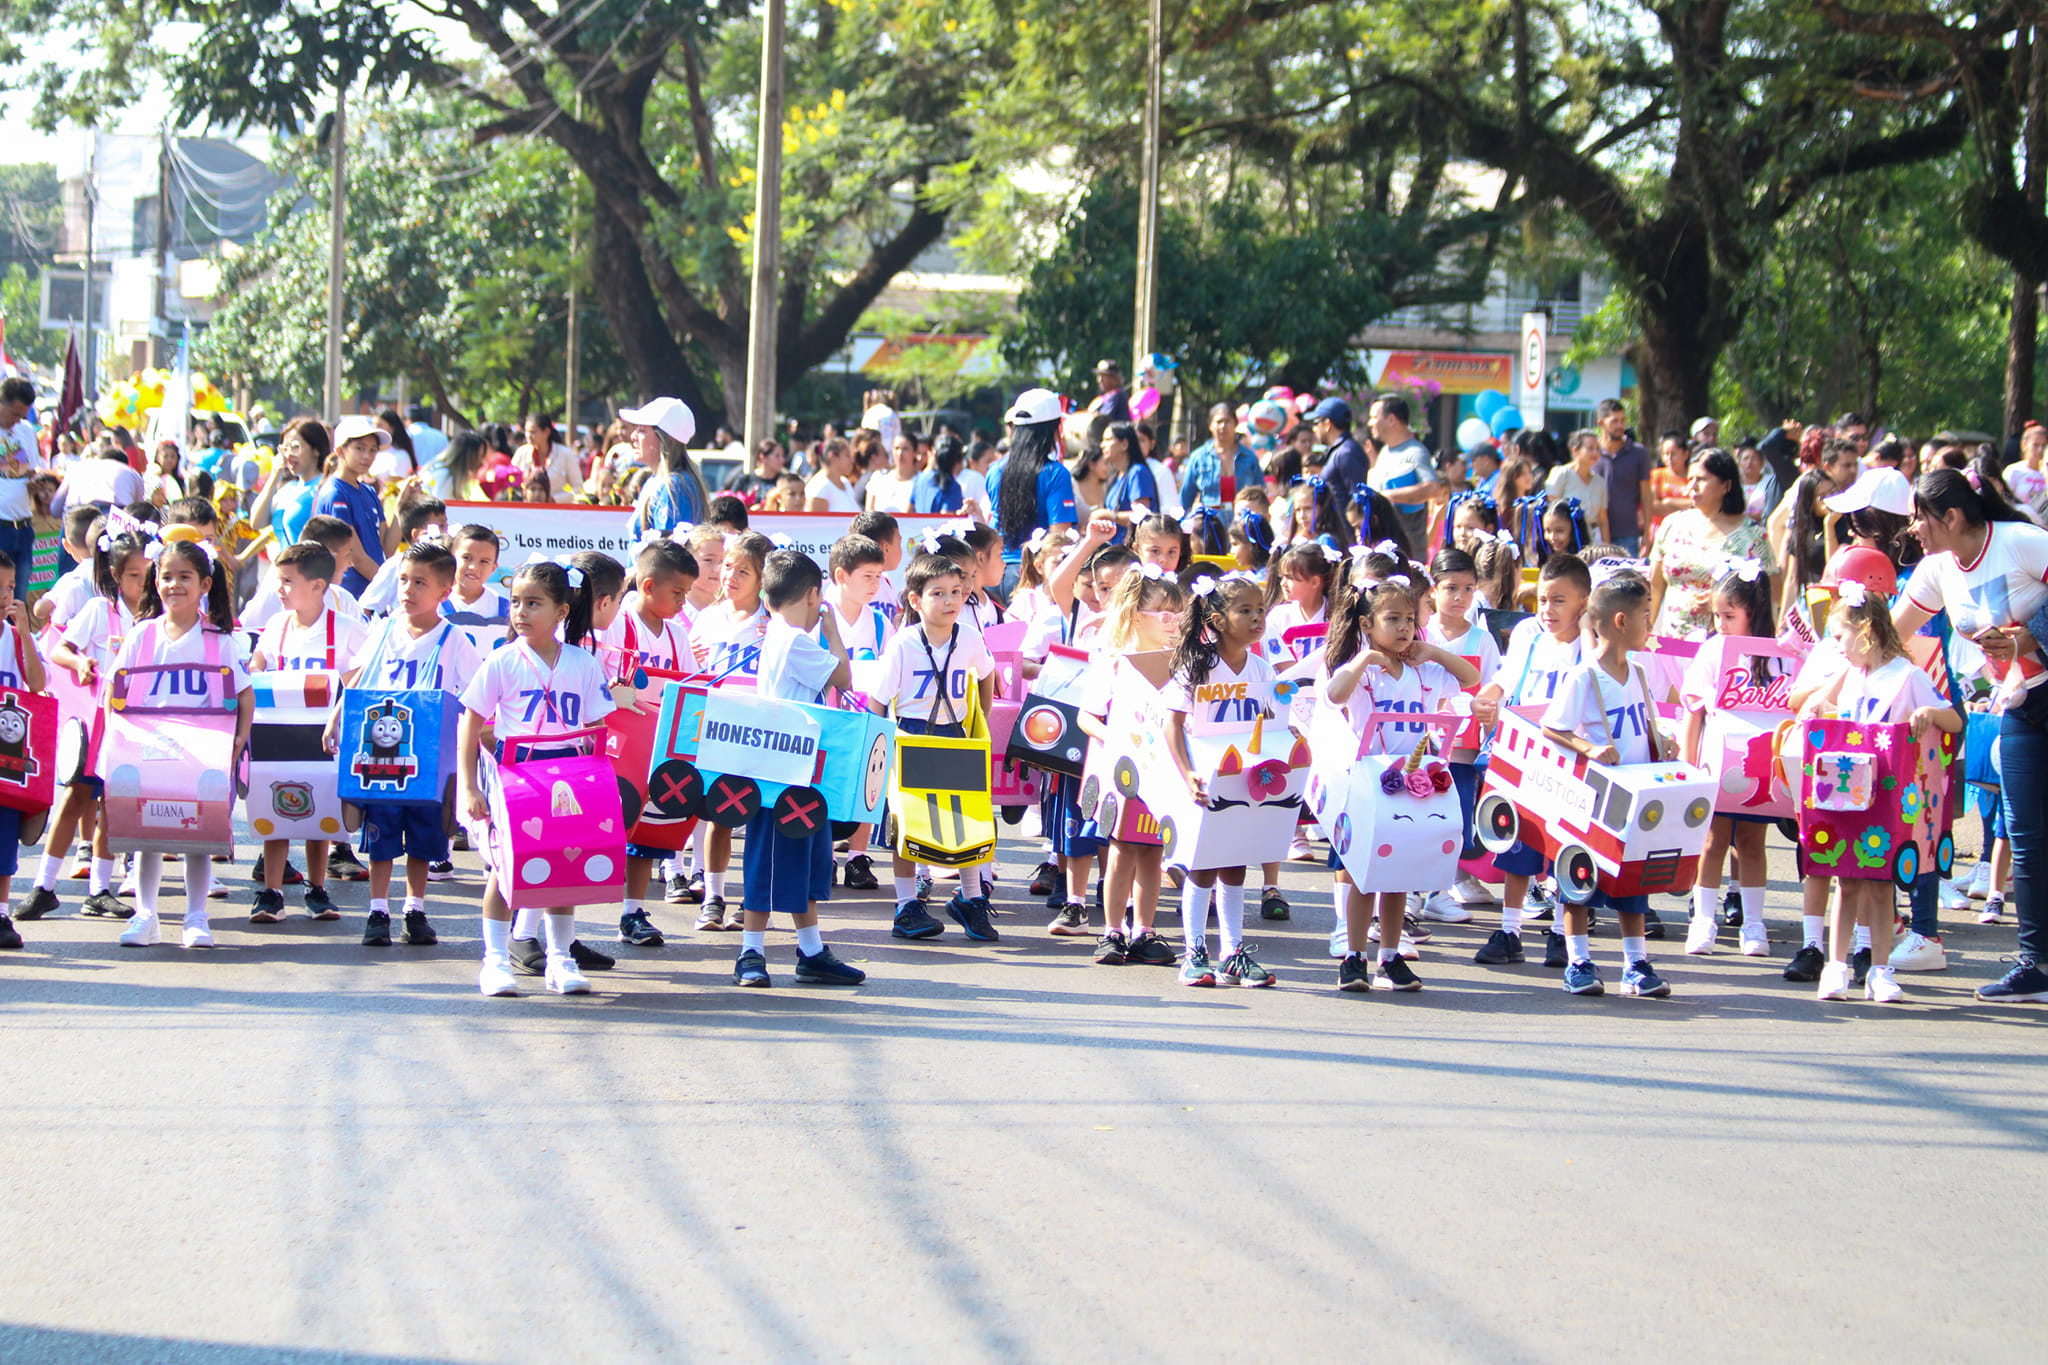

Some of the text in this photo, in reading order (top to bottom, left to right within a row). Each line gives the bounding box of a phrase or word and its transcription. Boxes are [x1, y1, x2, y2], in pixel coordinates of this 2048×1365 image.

[546, 535, 594, 549] medios
[598, 536, 614, 550] de
[913, 669, 966, 699] 70
[1197, 683, 1247, 703] NAYE
[1717, 667, 1793, 710] Barbi
[520, 689, 581, 727] 710
[706, 720, 815, 756] HONESTIDAD
[1528, 766, 1587, 810] JUSTICIA
[150, 804, 185, 818] LUANA
